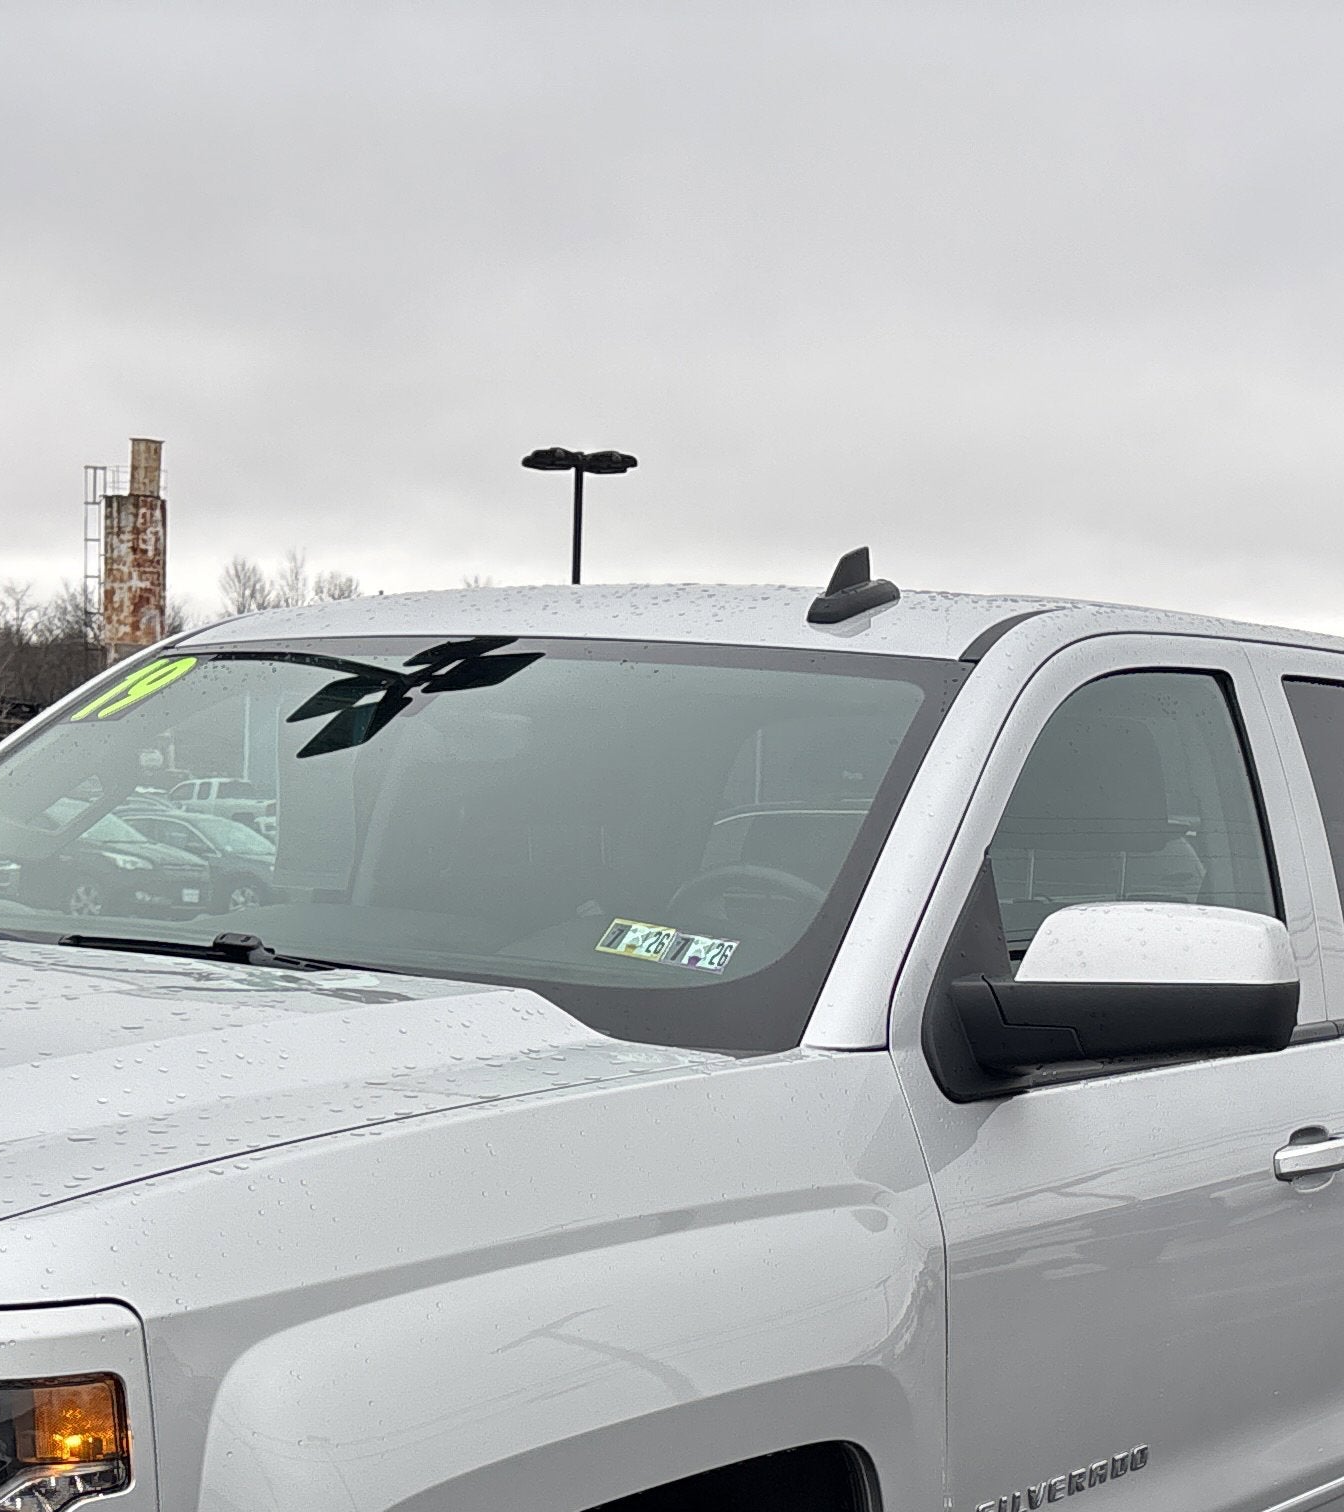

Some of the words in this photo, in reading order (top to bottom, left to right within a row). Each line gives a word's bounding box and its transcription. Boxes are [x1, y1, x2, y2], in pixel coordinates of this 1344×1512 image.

[607, 928, 624, 948] 7
[645, 932, 670, 954] 26
[671, 937, 694, 961] 7
[709, 943, 733, 967] 26
